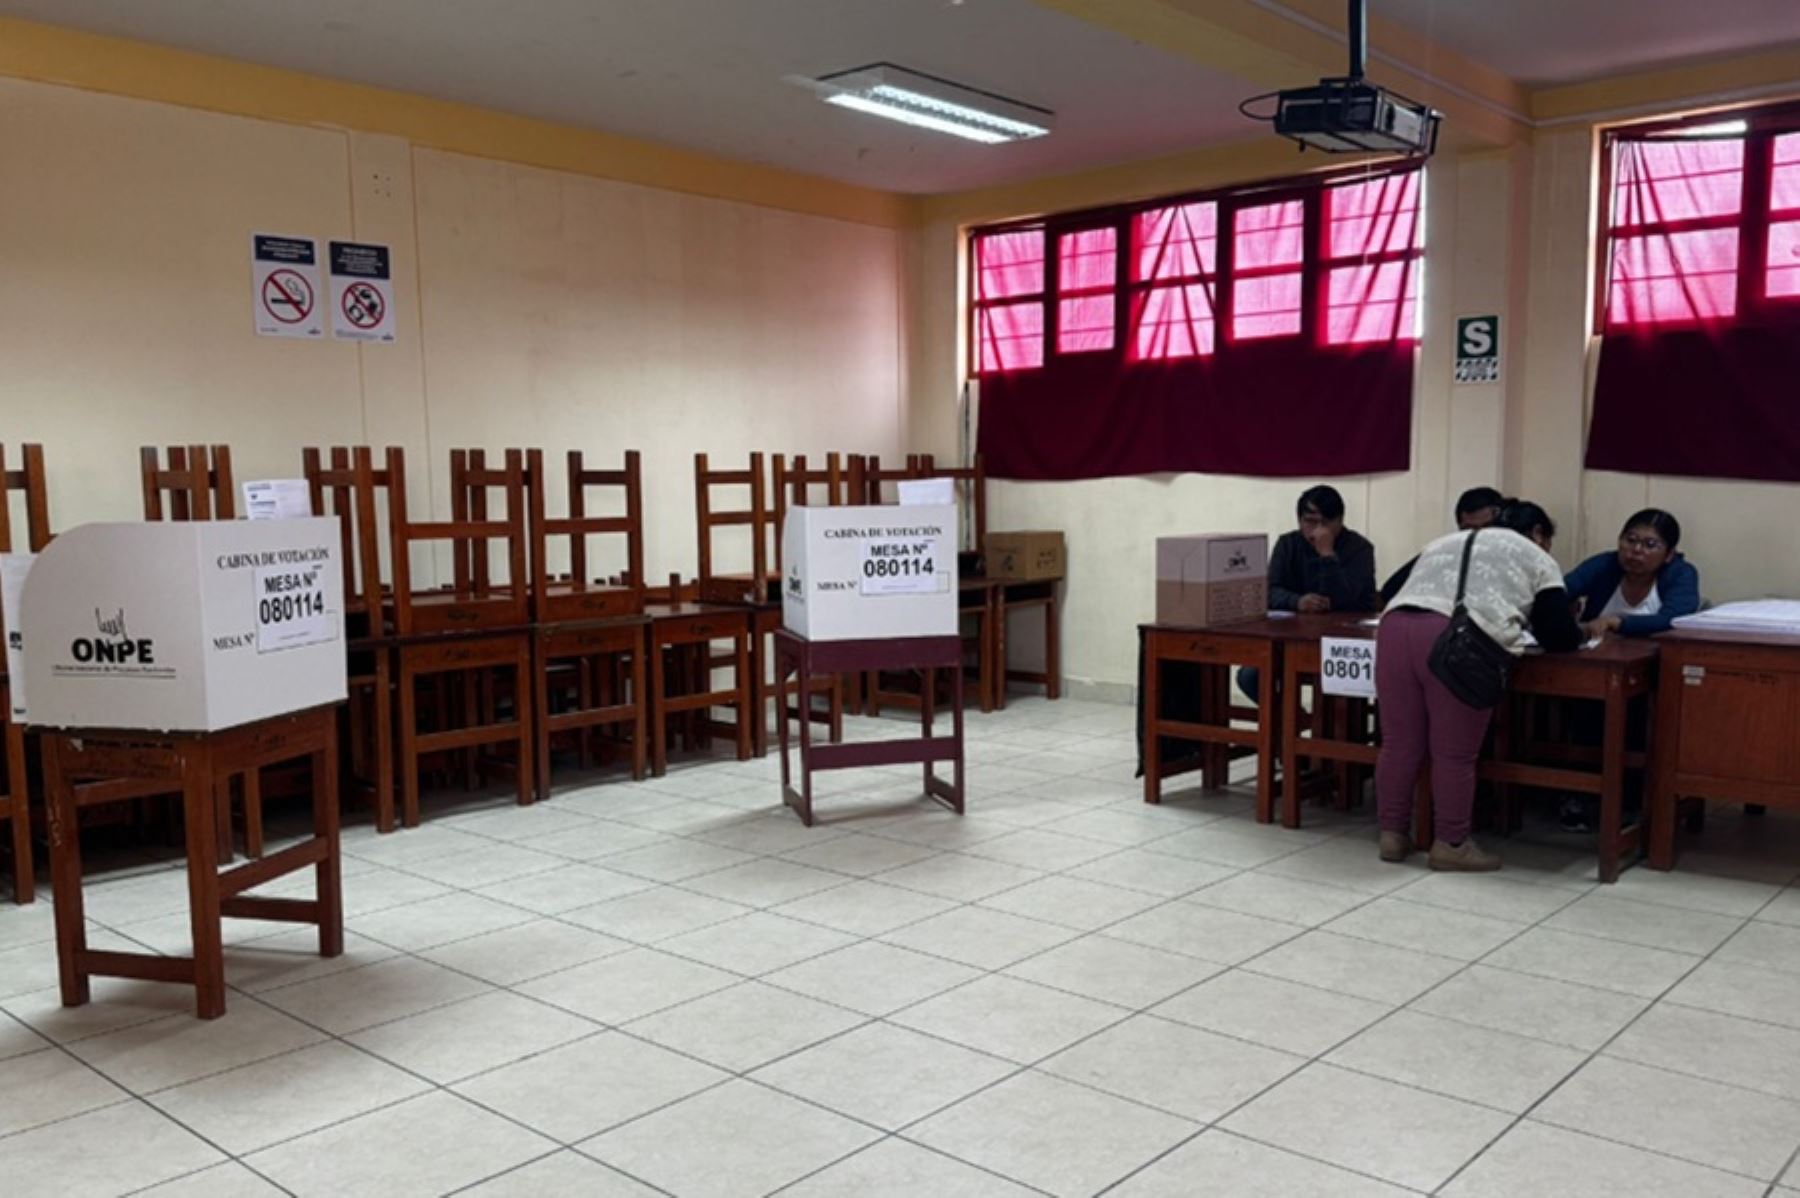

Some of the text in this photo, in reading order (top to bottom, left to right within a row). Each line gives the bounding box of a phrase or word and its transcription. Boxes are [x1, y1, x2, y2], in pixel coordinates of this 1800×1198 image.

[1463, 321, 1491, 355] S
[823, 528, 866, 538] CABINA
[868, 527, 884, 537] DE
[871, 544, 909, 557] MESA
[217, 552, 260, 570] CABINA
[261, 551, 276, 566] DE
[863, 557, 934, 578] 080114
[264, 573, 301, 593] MESA
[817, 582, 846, 591] MESA
[259, 589, 324, 625] 080114
[71, 637, 154, 663] ONPE
[213, 636, 242, 650] MESA
[1330, 645, 1372, 660] MESA
